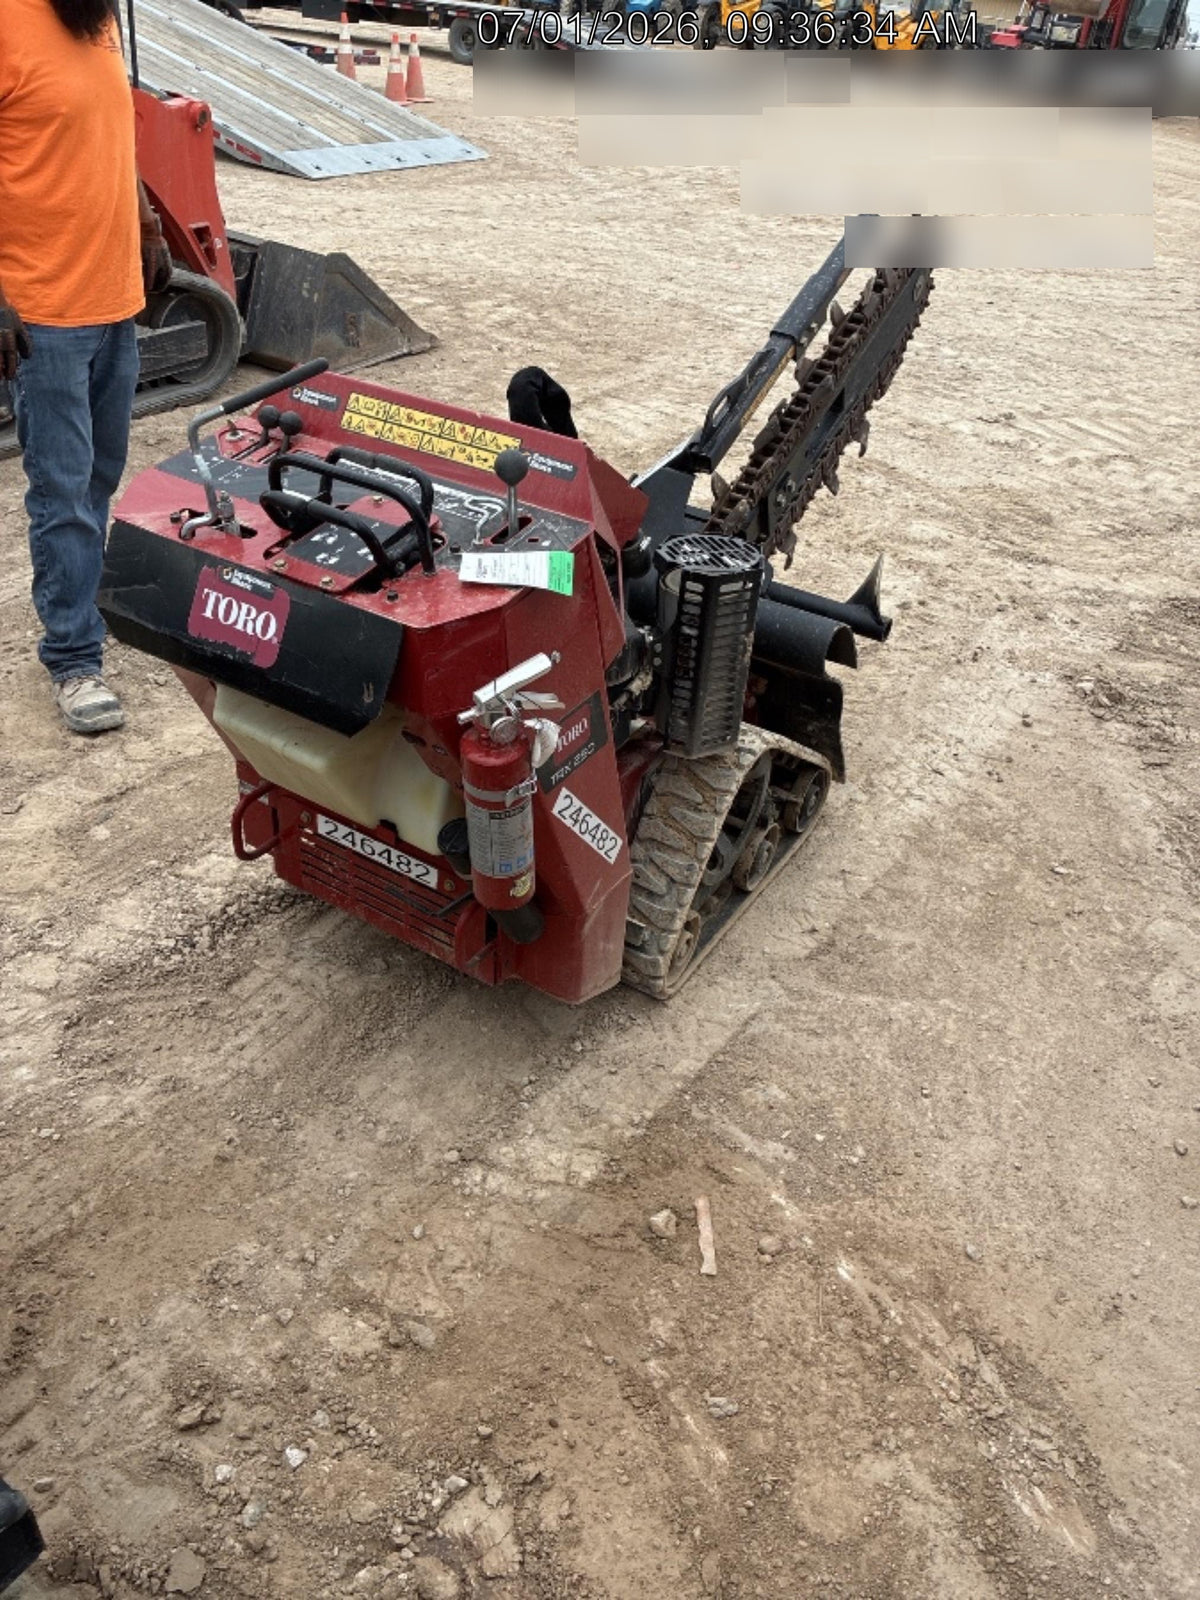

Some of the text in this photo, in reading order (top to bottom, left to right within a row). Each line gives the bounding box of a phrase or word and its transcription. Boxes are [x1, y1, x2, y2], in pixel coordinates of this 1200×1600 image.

[201, 588, 277, 641] TORO
[556, 717, 588, 753] TORO
[324, 820, 431, 884] 246482
[558, 794, 618, 860] 246482
